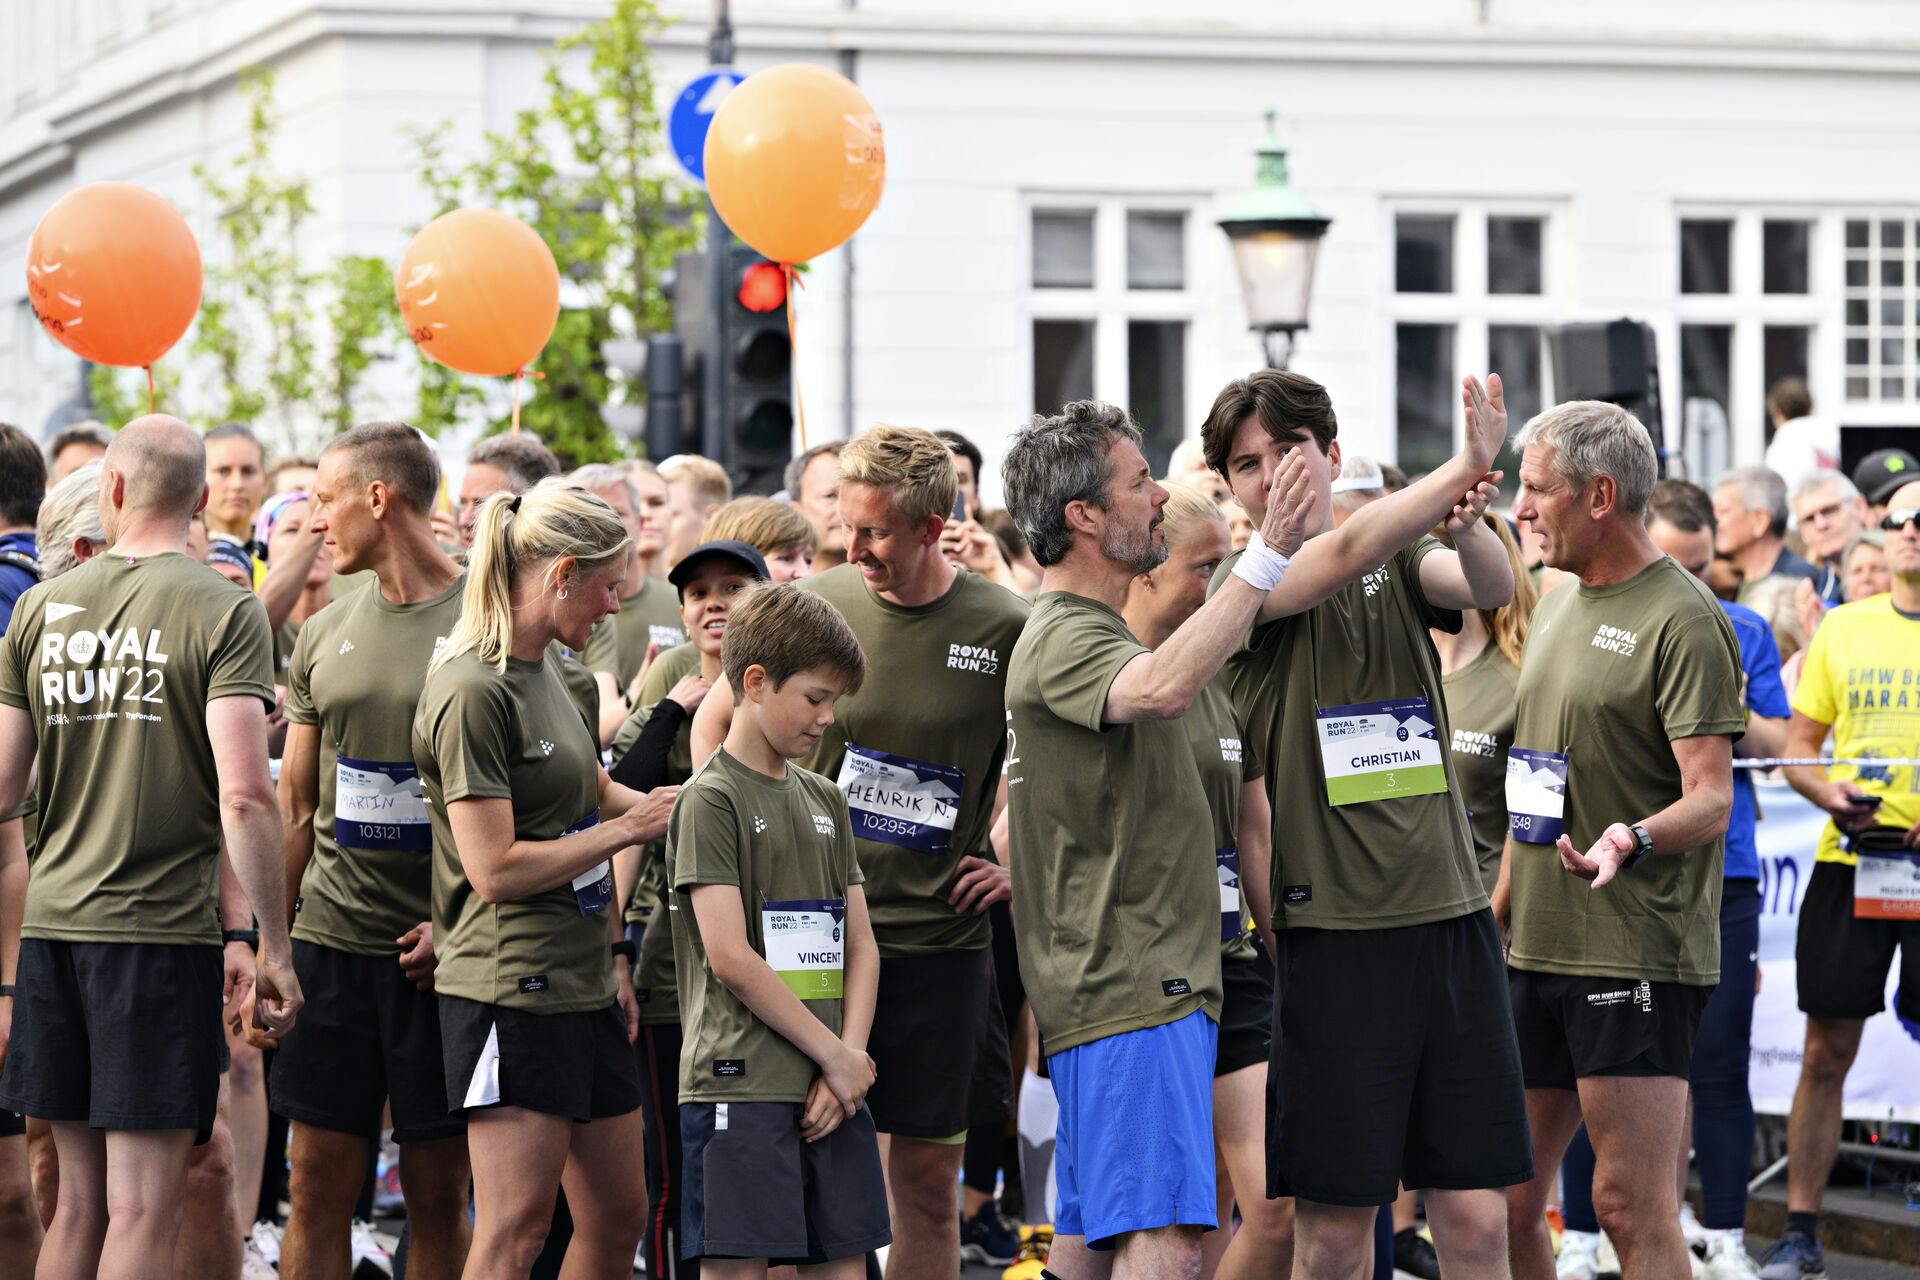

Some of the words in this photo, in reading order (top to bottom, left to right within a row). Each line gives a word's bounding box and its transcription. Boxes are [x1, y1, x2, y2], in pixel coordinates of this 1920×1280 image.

[1597, 624, 1638, 645] ROYAL
[41, 627, 169, 667] ROYAL
[949, 643, 999, 662] ROYAL
[1326, 720, 1355, 731] ROYAL
[1453, 729, 1498, 747] ROYAL
[1351, 749, 1421, 769] CHRISTIAN
[1386, 773, 1396, 787] 3
[341, 794, 394, 810] MARTIN
[847, 782, 923, 812] HENRIK
[359, 824, 401, 840] 103121
[863, 813, 917, 838] 102954
[770, 915, 797, 923] ROYAL
[798, 951, 841, 964] VINCENT
[821, 972, 828, 987] 5
[1640, 980, 1652, 1012] FUSIO
